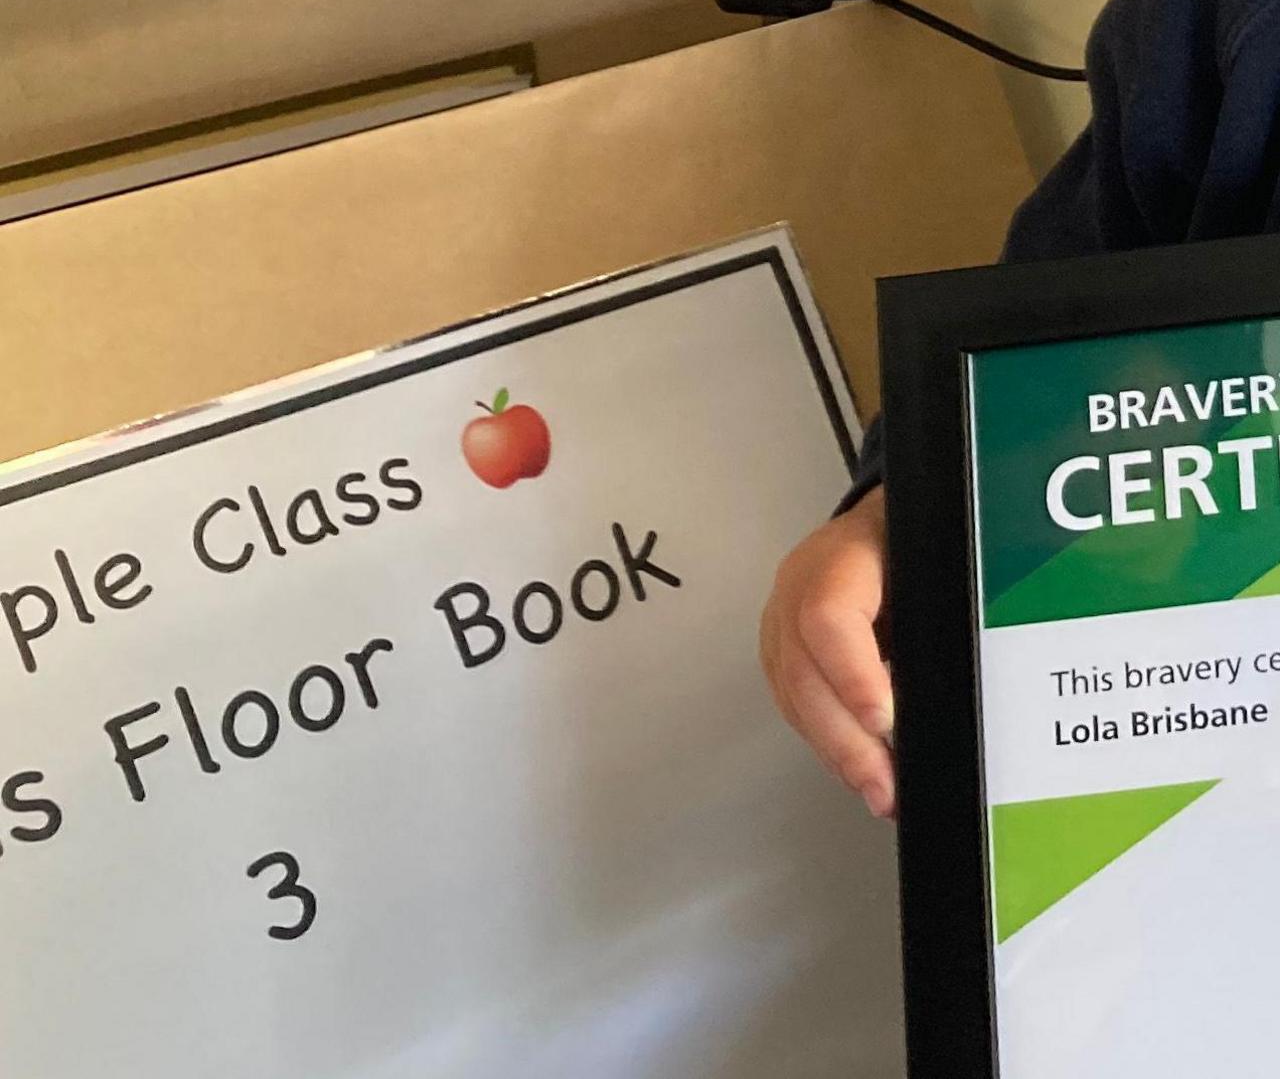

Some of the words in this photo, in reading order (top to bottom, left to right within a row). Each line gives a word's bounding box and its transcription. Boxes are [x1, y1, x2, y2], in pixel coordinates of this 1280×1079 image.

[0, 549, 153, 673] ple
[192, 457, 423, 574] Class
[104, 637, 393, 802] Floor
[433, 522, 682, 669] Book
[1050, 668, 1114, 699] This
[1123, 650, 1243, 691] bravery
[1054, 711, 1120, 747] Lola
[1130, 698, 1269, 739] Brisbane
[246, 851, 318, 941] 3
